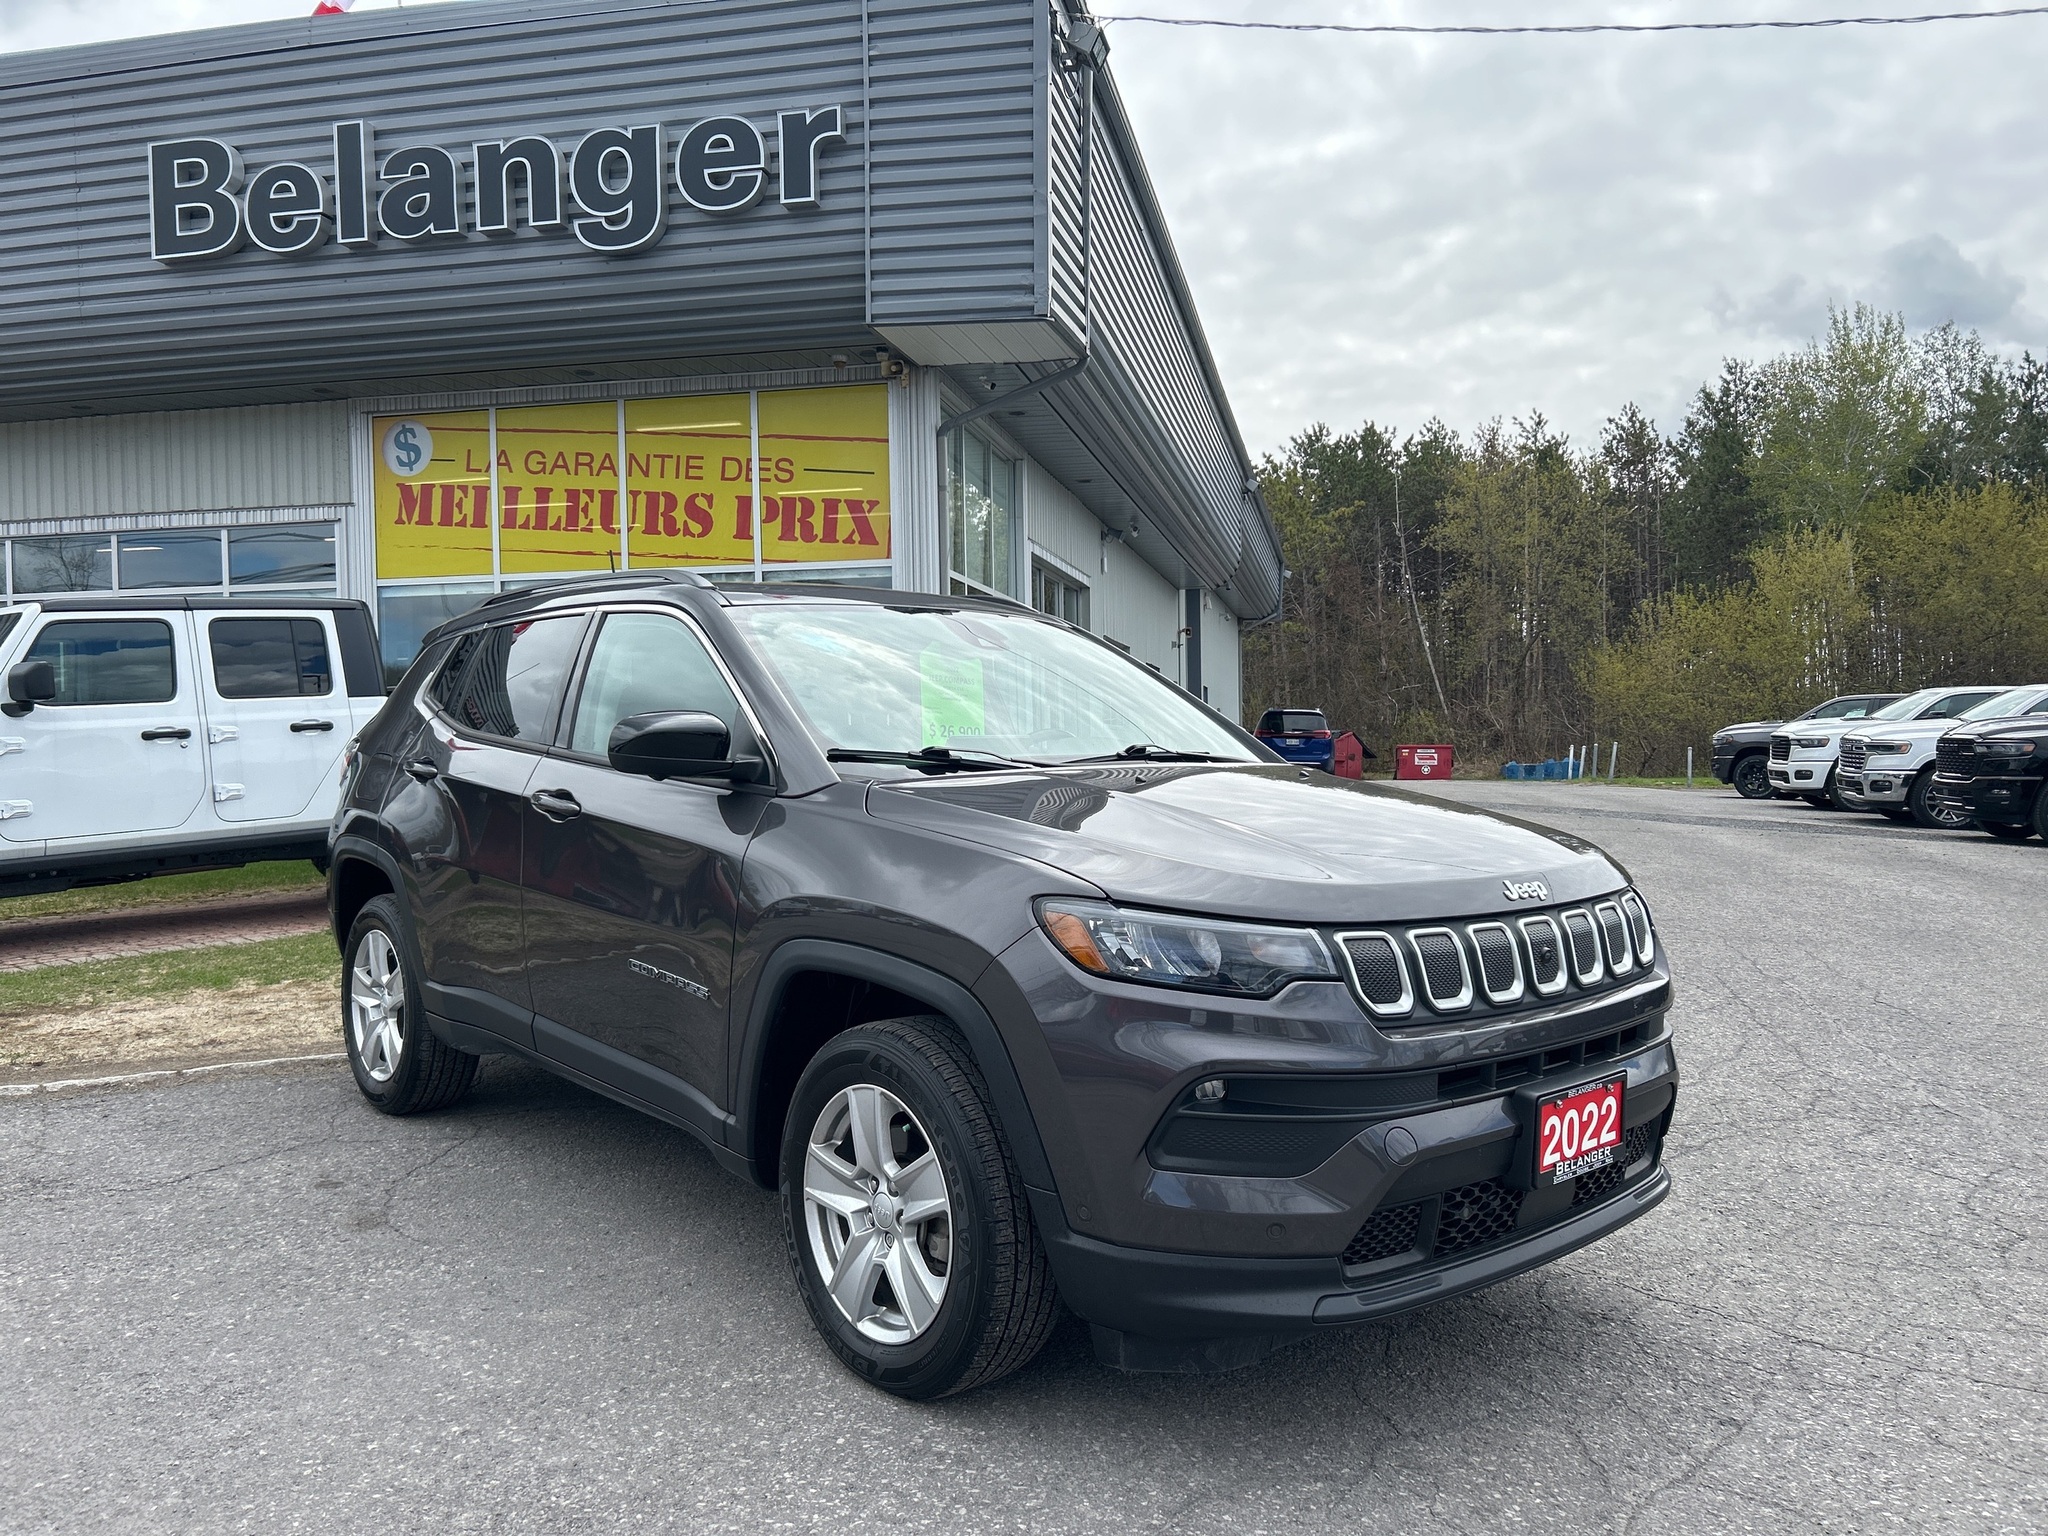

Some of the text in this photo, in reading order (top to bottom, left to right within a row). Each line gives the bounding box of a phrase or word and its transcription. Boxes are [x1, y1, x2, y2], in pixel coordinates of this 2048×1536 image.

[147, 103, 845, 262] Belanger
[393, 424, 422, 471] $
[466, 449, 795, 483] LA GARANTIE DES
[394, 482, 880, 546] MEILLEURS PRIX
[944, 675, 975, 686] COMPASS
[1502, 879, 1548, 901] Jeep
[627, 958, 711, 1000] COMPASS
[1543, 1095, 1617, 1167] 2022
[1555, 1146, 1611, 1176] BELANGER
